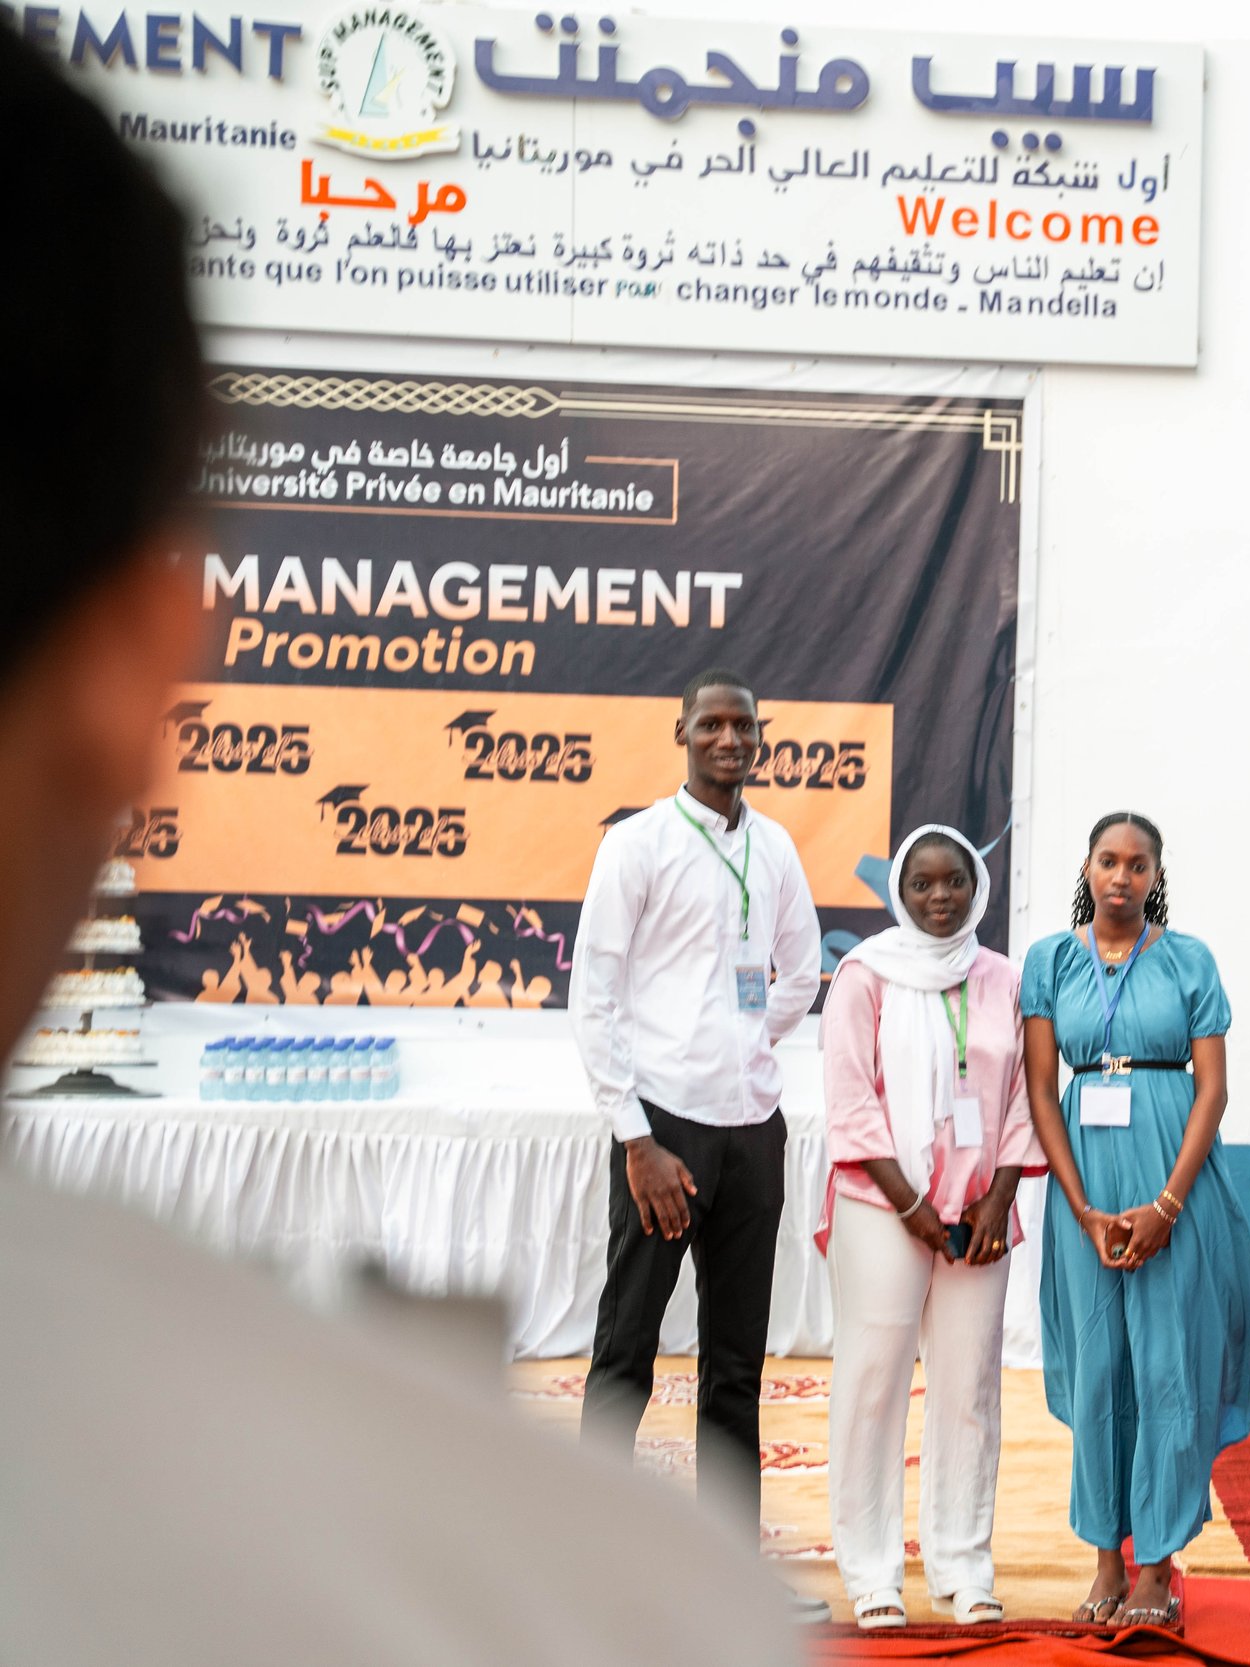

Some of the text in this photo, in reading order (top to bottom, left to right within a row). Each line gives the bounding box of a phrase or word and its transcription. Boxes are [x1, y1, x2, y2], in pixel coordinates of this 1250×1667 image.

[0, 4, 303, 80] EMENT
[475, 13, 1157, 152] سيب منجمنت
[118, 112, 297, 150] Mauritanie
[472, 130, 613, 173] موريتانيا
[631, 139, 683, 187] في
[699, 143, 756, 177] الحر
[768, 147, 869, 194] العالي
[882, 154, 998, 194] للتعليم
[1012, 155, 1099, 197] شبكة
[1118, 154, 1170, 202] أول
[301, 159, 467, 225] مرحبا
[897, 195, 1160, 246] Welcome
[432, 225, 472, 264] بها
[553, 233, 613, 269] كبيرة
[623, 230, 674, 271] ثروة
[688, 239, 743, 267] ذاته
[757, 249, 790, 268] حد
[801, 241, 838, 286] في
[265, 261, 322, 287] que
[398, 263, 497, 293] puisse
[506, 270, 607, 297] utiliser
[677, 278, 799, 311] changer
[980, 290, 1118, 318] Mandella
[973, 255, 1049, 284] الناس
[1061, 256, 1121, 293] تعليم
[1133, 259, 1165, 293] إن
[206, 432, 569, 480] أول جامعة خاصة في موريتاني
[345, 470, 442, 504] Privée
[449, 482, 486, 506] en
[493, 477, 655, 512] Mauritanie
[202, 553, 743, 629] MANAGEMENT
[224, 617, 536, 676] Promotion
[178, 722, 311, 774] 2025
[464, 732, 593, 783] 2025
[744, 741, 866, 790] 2025
[336, 806, 467, 857] 2025
